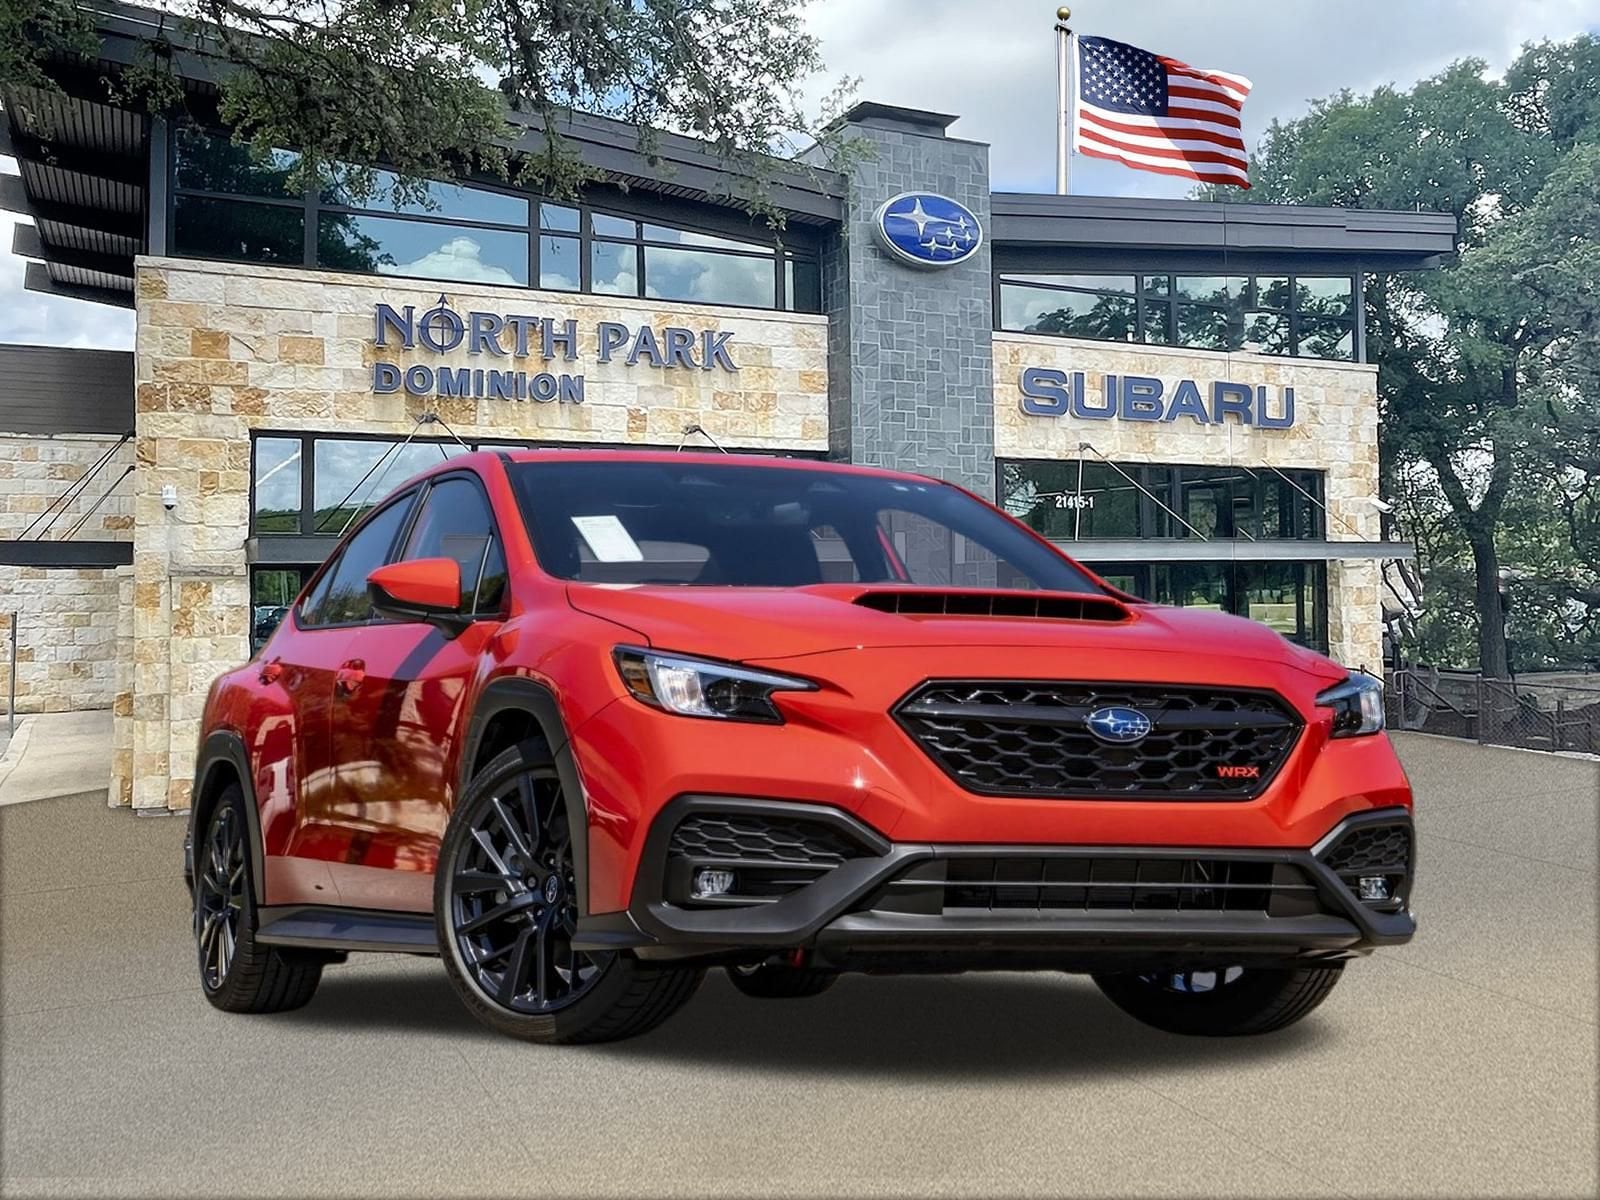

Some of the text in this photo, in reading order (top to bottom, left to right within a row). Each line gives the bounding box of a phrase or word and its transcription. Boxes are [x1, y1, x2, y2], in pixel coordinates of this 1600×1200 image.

[375, 294, 741, 372] NORTH PARK
[373, 363, 584, 402] DOMINION
[1019, 367, 1294, 428] SUBARU
[1217, 766, 1259, 777] WRX
